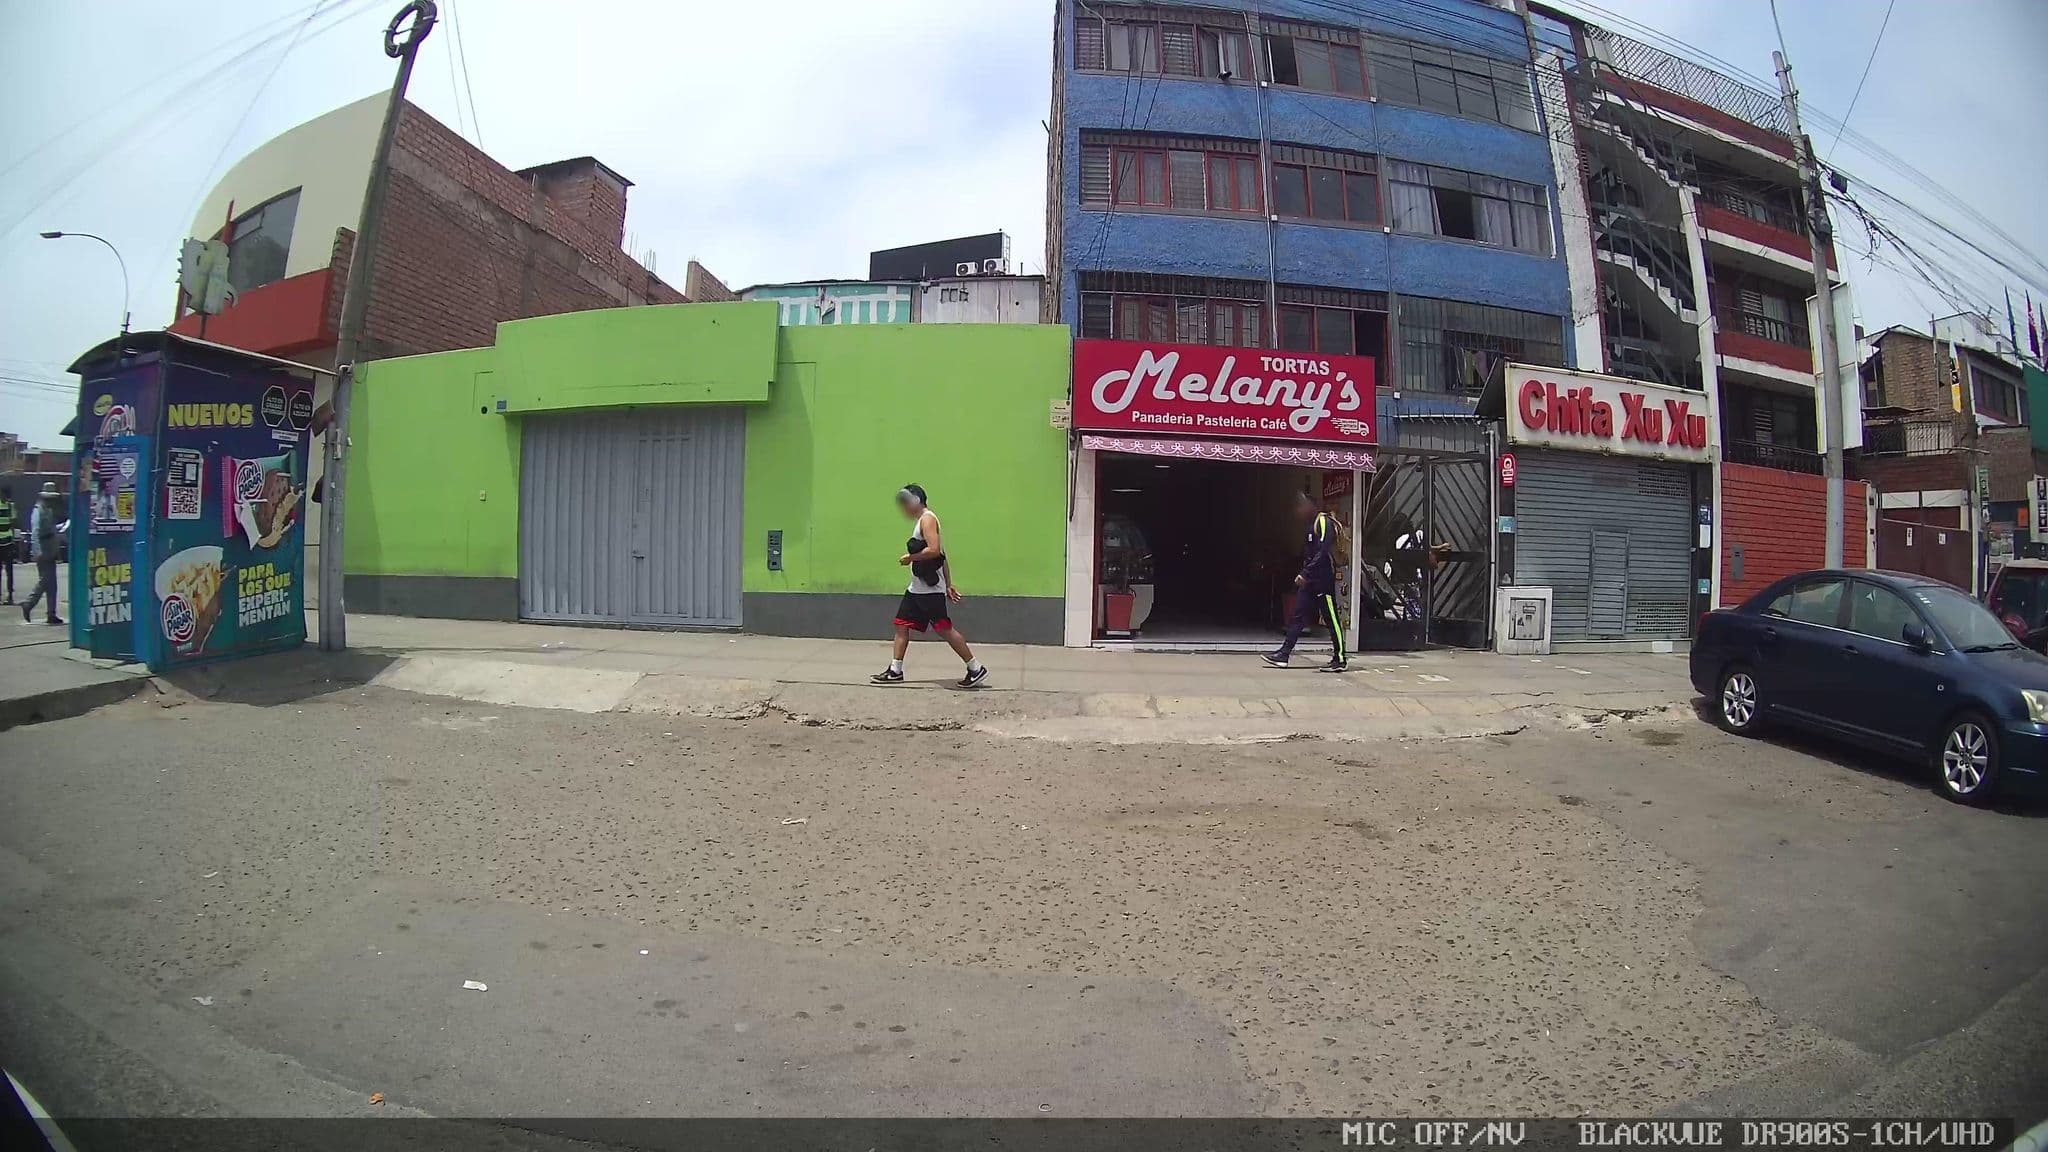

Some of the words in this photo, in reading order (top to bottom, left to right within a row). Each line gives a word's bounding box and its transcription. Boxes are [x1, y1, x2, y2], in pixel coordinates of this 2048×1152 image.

[1261, 356, 1330, 375] TORTAS
[1091, 350, 1361, 433] Melany's
[168, 402, 254, 428] NUEVOS
[1132, 410, 1193, 426] Panaderia
[1196, 413, 1257, 429] Pasteleria
[1260, 416, 1287, 431] Café
[1519, 379, 1614, 438] Chifa
[1620, 392, 1663, 444] Xu
[1664, 399, 1707, 448] Xu
[95, 562, 132, 586] QUE
[239, 579, 264, 598] LOS
[265, 572, 291, 591] QUE
[88, 585, 128, 606] ERI-
[239, 588, 289, 613] EXPERI-
[239, 600, 291, 627] MENTAN
